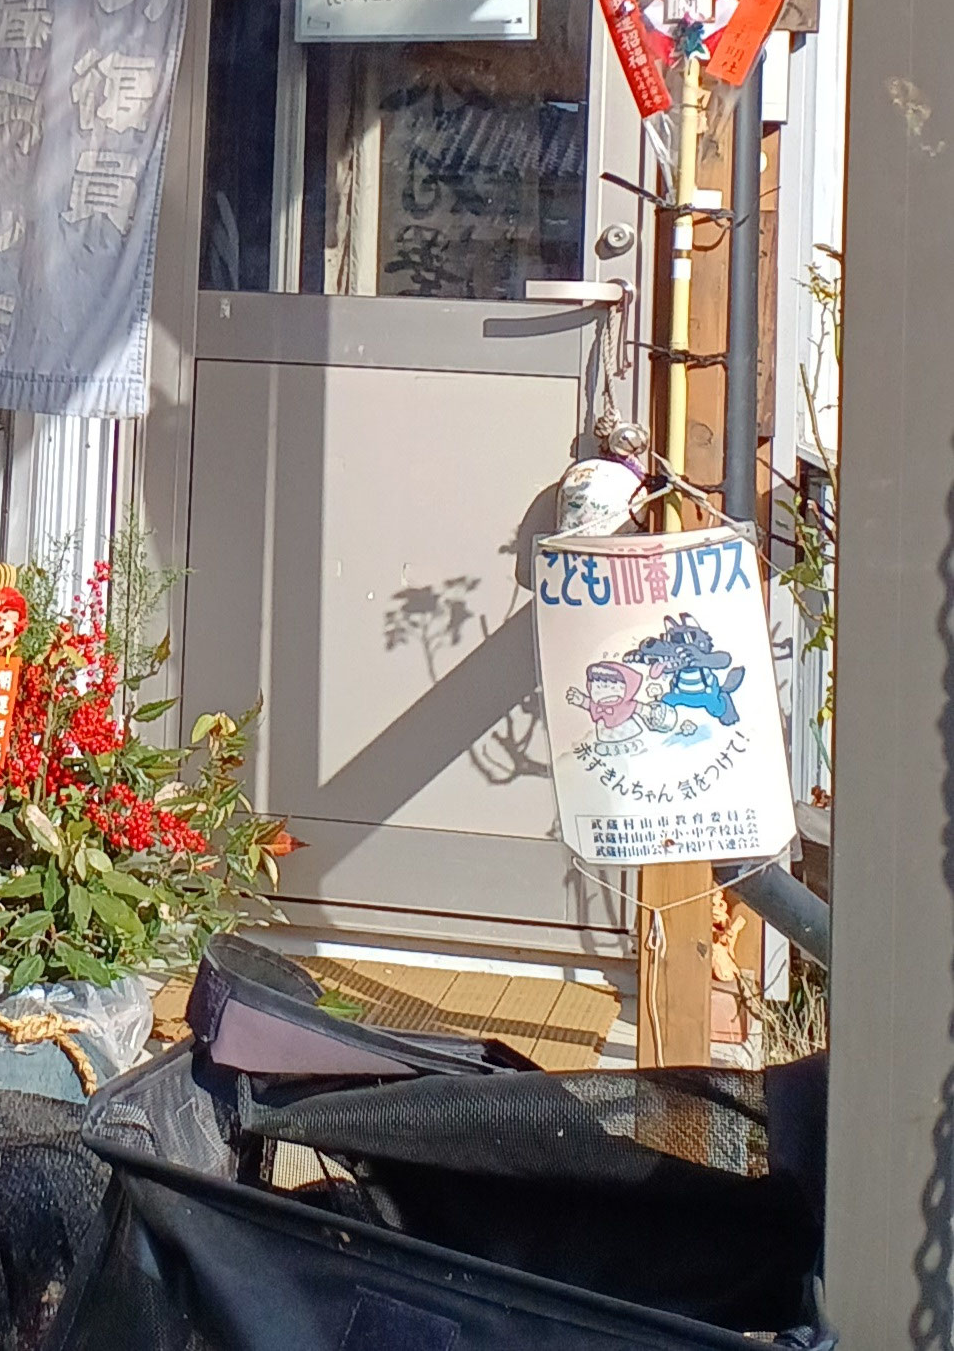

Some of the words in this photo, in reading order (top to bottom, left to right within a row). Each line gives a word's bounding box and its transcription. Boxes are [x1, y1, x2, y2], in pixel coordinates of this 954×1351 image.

[572, 742, 674, 804] 赤ずきんちゃん
